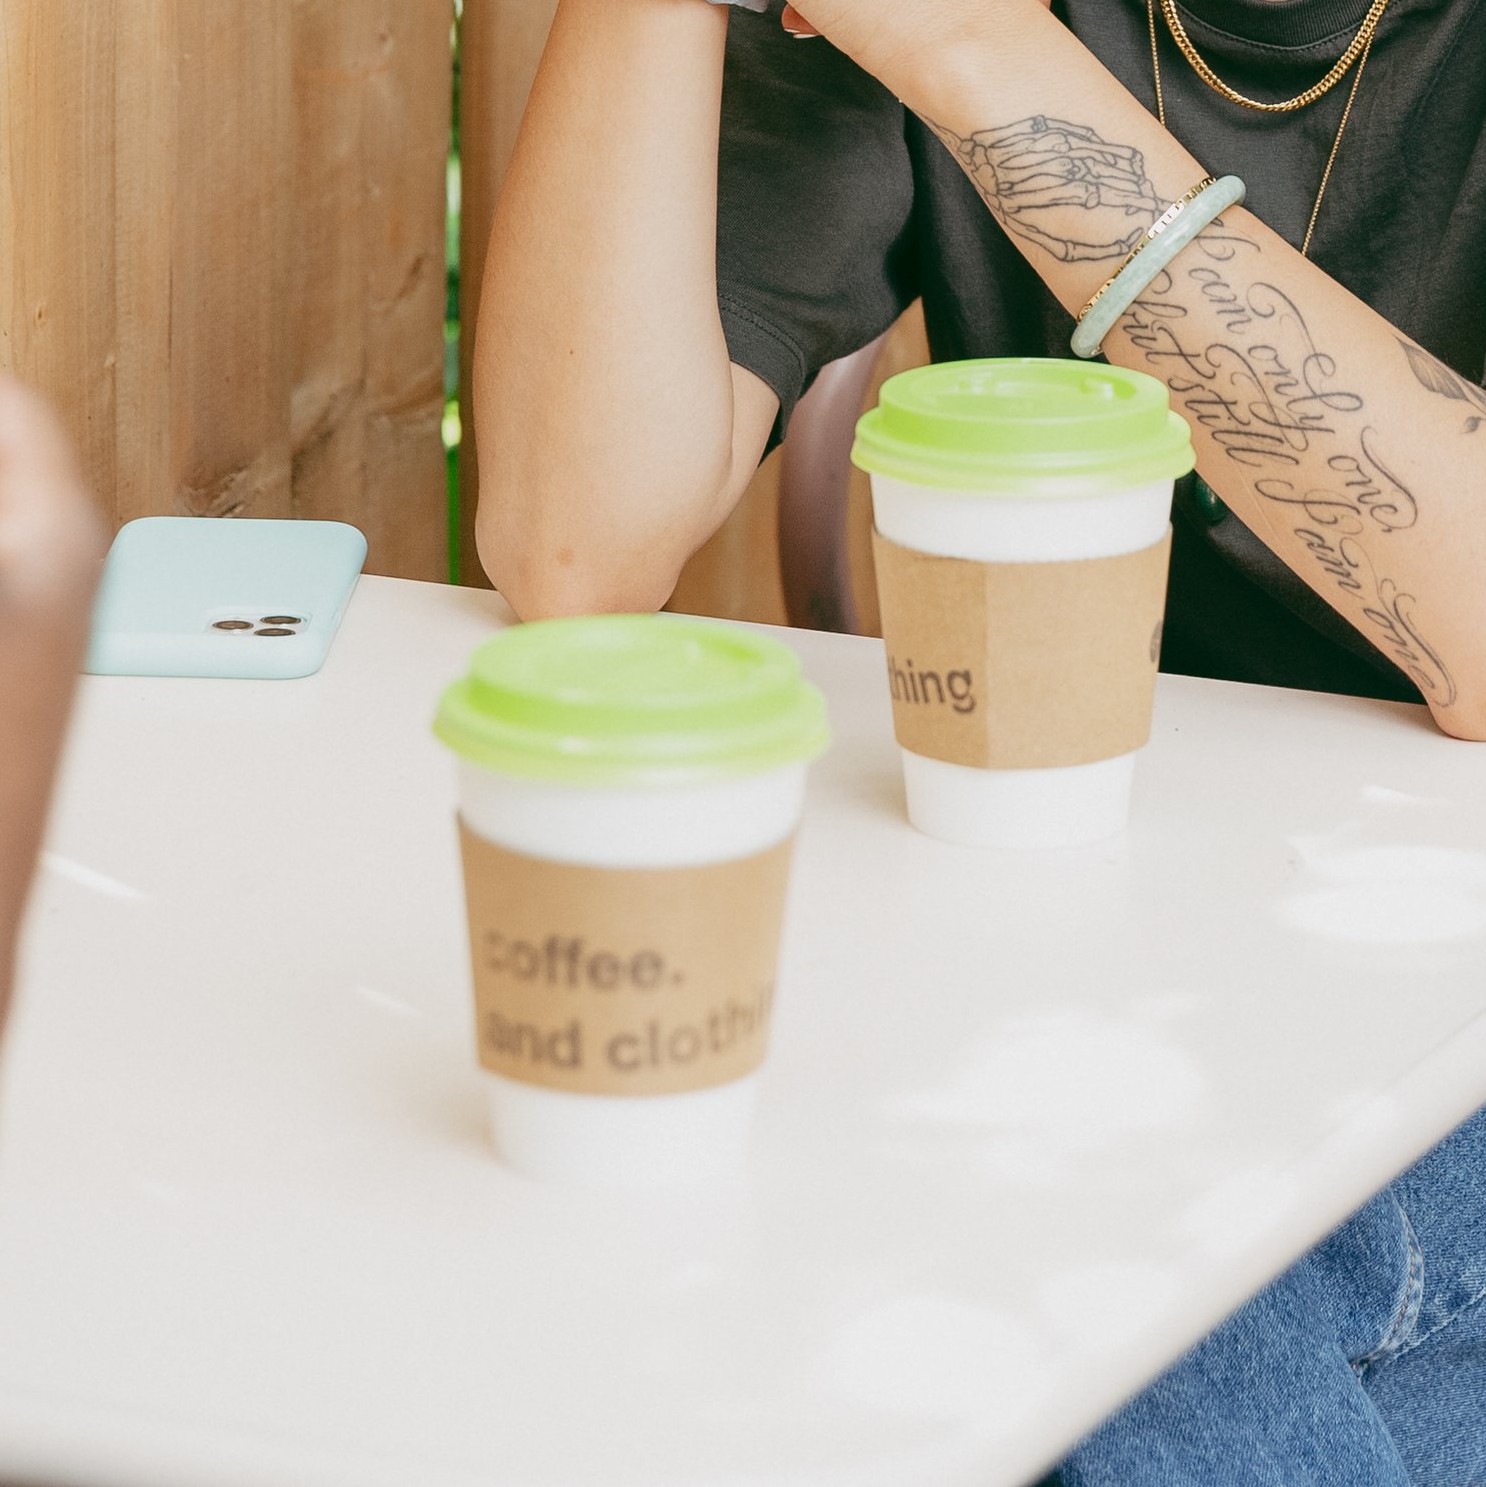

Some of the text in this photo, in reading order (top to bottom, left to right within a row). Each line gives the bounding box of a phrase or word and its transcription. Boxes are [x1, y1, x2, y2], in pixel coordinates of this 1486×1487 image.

[1122, 271, 1216, 380] but
[1188, 267, 1253, 336] am
[1246, 282, 1364, 435] only
[1167, 375, 1300, 468] still
[1293, 527, 1366, 601] am
[1363, 590, 1458, 708] one
[483, 930, 685, 990] coffee.
[485, 1011, 583, 1072] and
